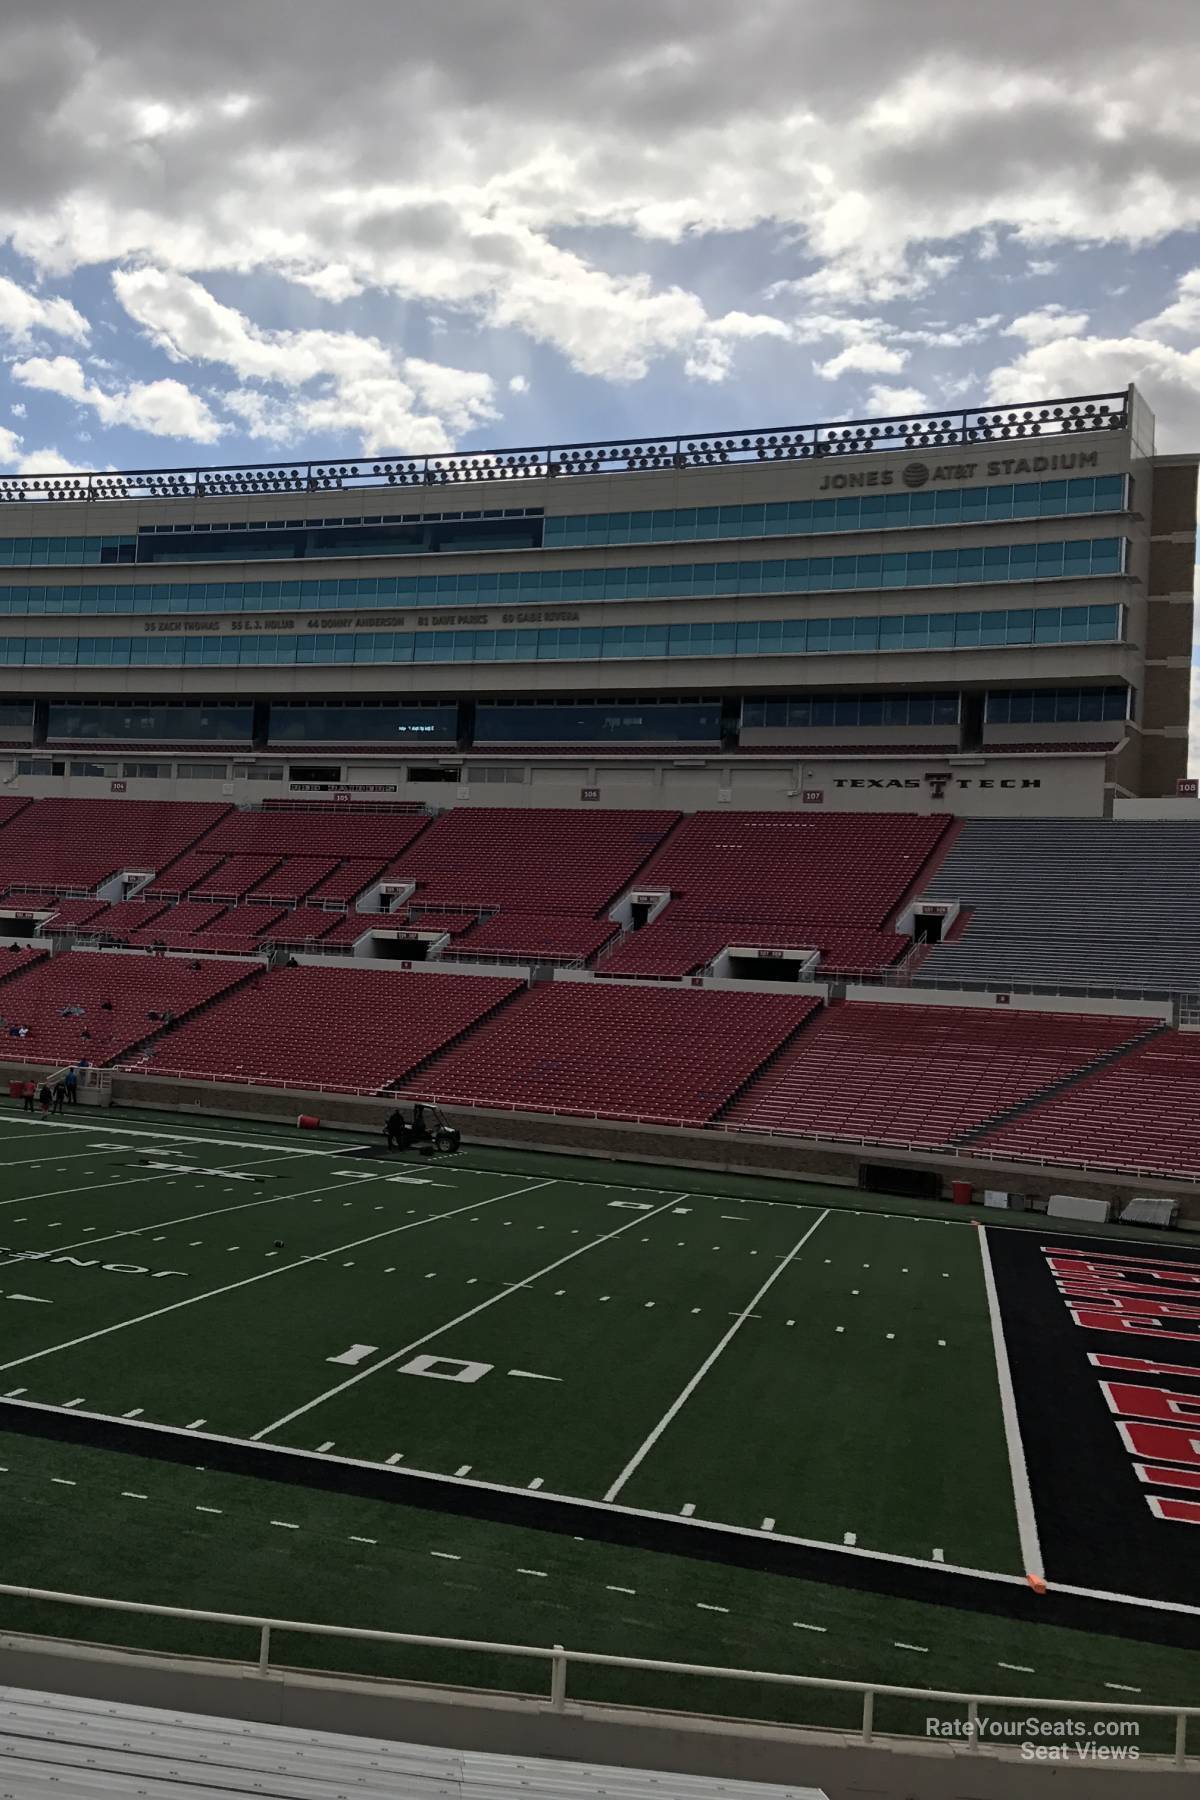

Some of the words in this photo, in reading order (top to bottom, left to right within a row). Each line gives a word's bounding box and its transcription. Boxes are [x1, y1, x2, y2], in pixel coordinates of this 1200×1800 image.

[819, 470, 894, 490] JONES
[931, 463, 978, 481] AT&T
[987, 450, 1098, 477] STADIUM
[833, 779, 920, 788] TEXAS
[956, 779, 1041, 788] TECH
[1180, 783, 1196, 792] 108
[806, 792, 821, 800] 107
[325, 1344, 495, 1384] 10
